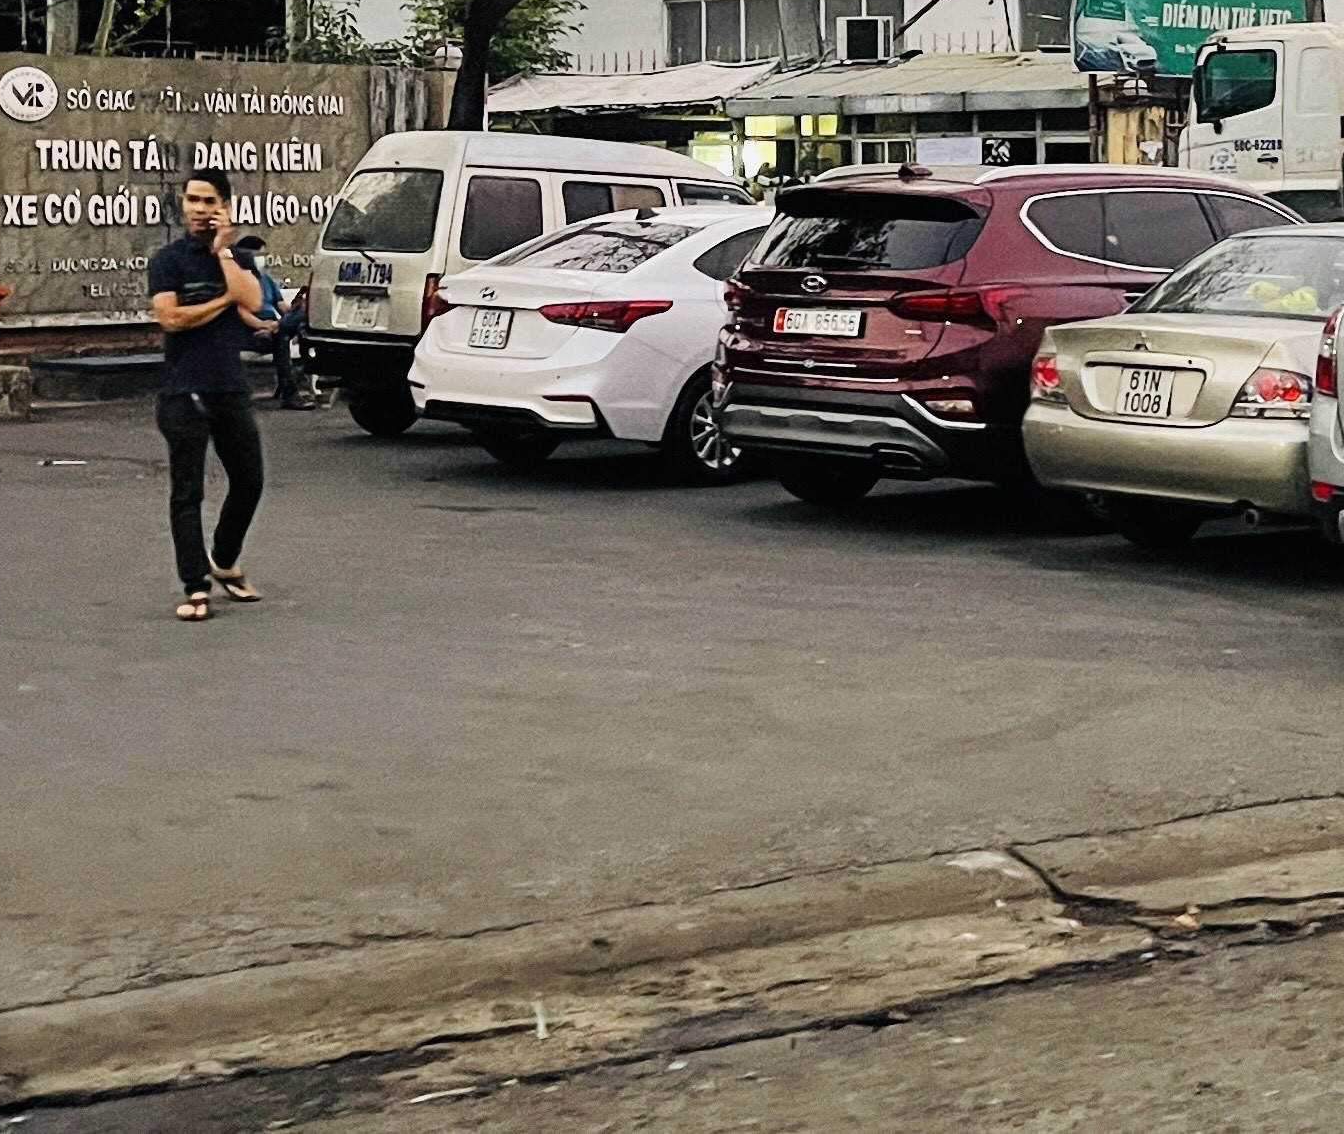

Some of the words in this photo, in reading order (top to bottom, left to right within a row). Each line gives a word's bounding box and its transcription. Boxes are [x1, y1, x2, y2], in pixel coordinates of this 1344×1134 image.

[66, 79, 92, 111] SỞ
[204, 86, 238, 118] VẬN
[317, 95, 345, 116] NAI
[35, 138, 122, 171] TRUNG
[3, 193, 38, 227] XE
[44, 187, 82, 226] CƠ
[87, 184, 138, 227] GIỚI
[481, 311, 502, 327] 60A
[1129, 370, 1163, 392] 61N
[1123, 392, 1162, 414] 1008
